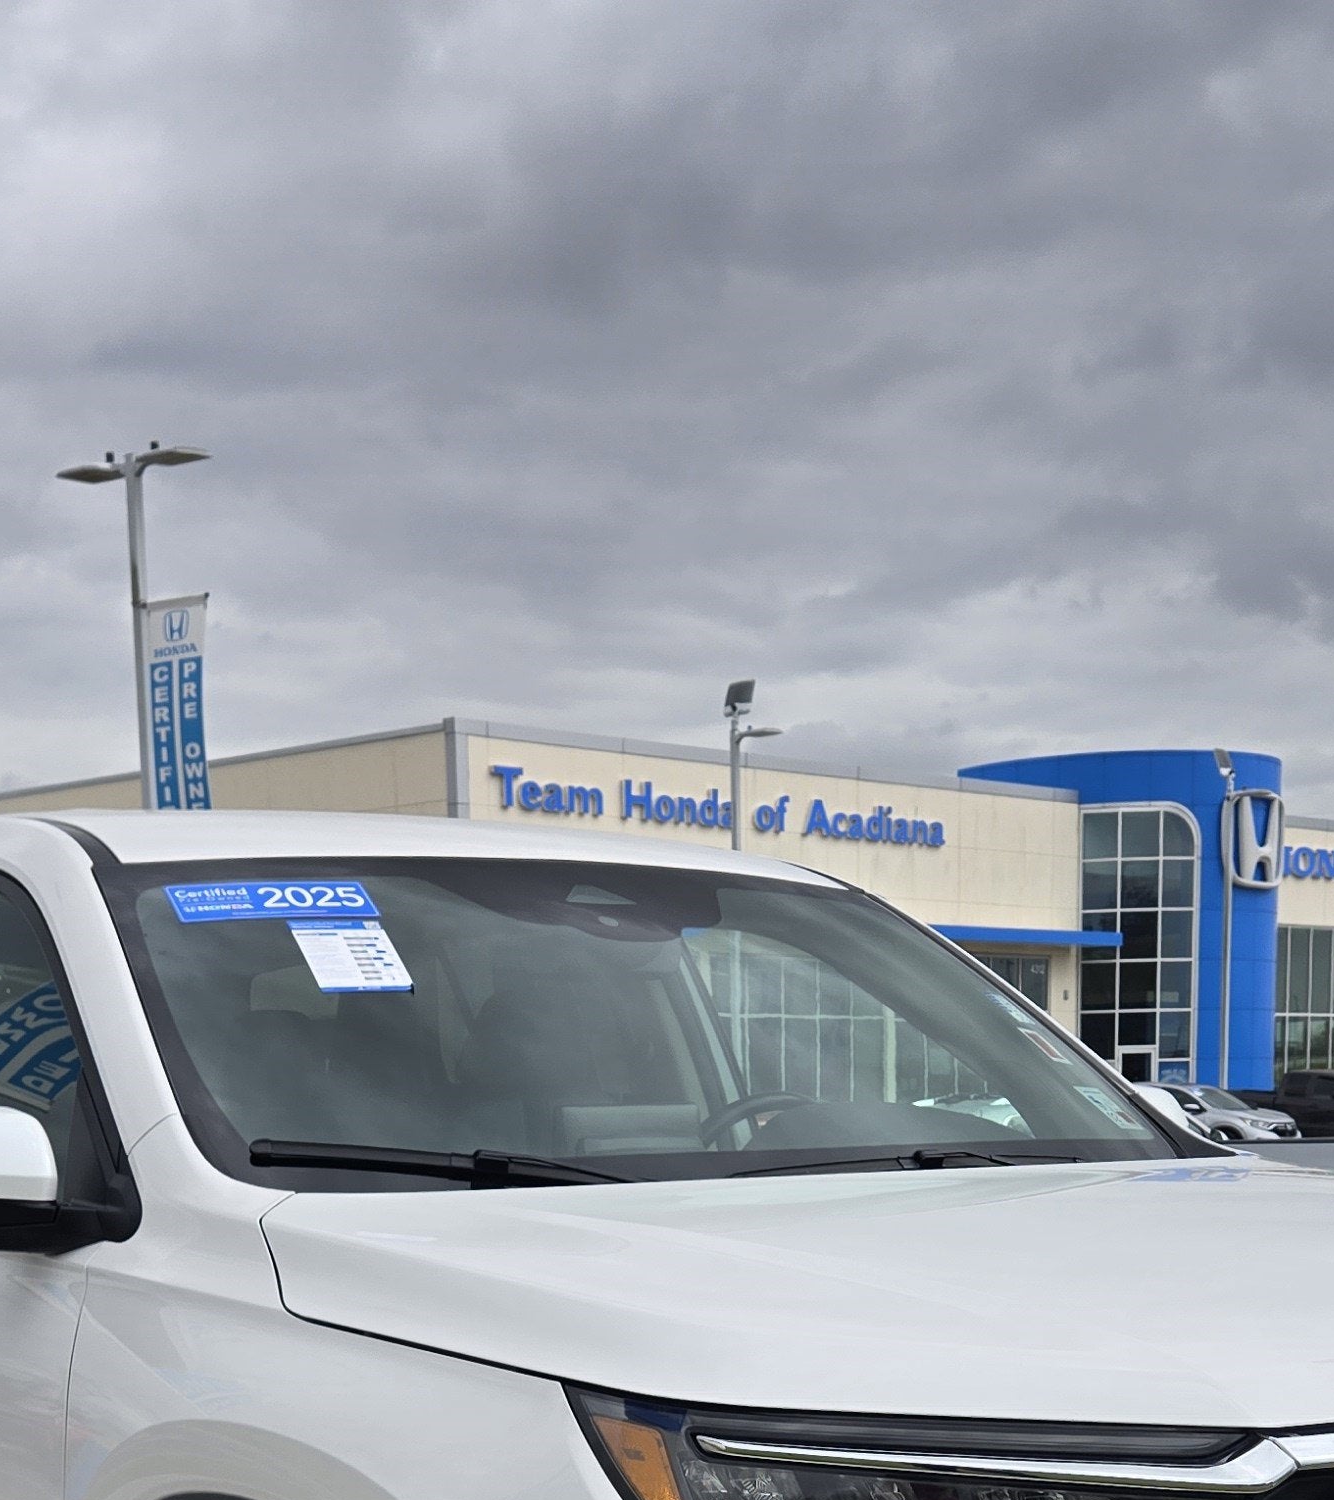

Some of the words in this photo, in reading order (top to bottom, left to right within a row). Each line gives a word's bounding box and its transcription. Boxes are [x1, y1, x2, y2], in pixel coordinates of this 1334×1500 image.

[154, 643, 198, 658] HONDA
[182, 662, 197, 719] PRE
[153, 666, 176, 809] CERTIFI
[489, 764, 604, 817] Team
[754, 795, 790, 835] of
[802, 798, 946, 847] Acadiana
[174, 886, 248, 899] Certified
[257, 886, 365, 908] 2025
